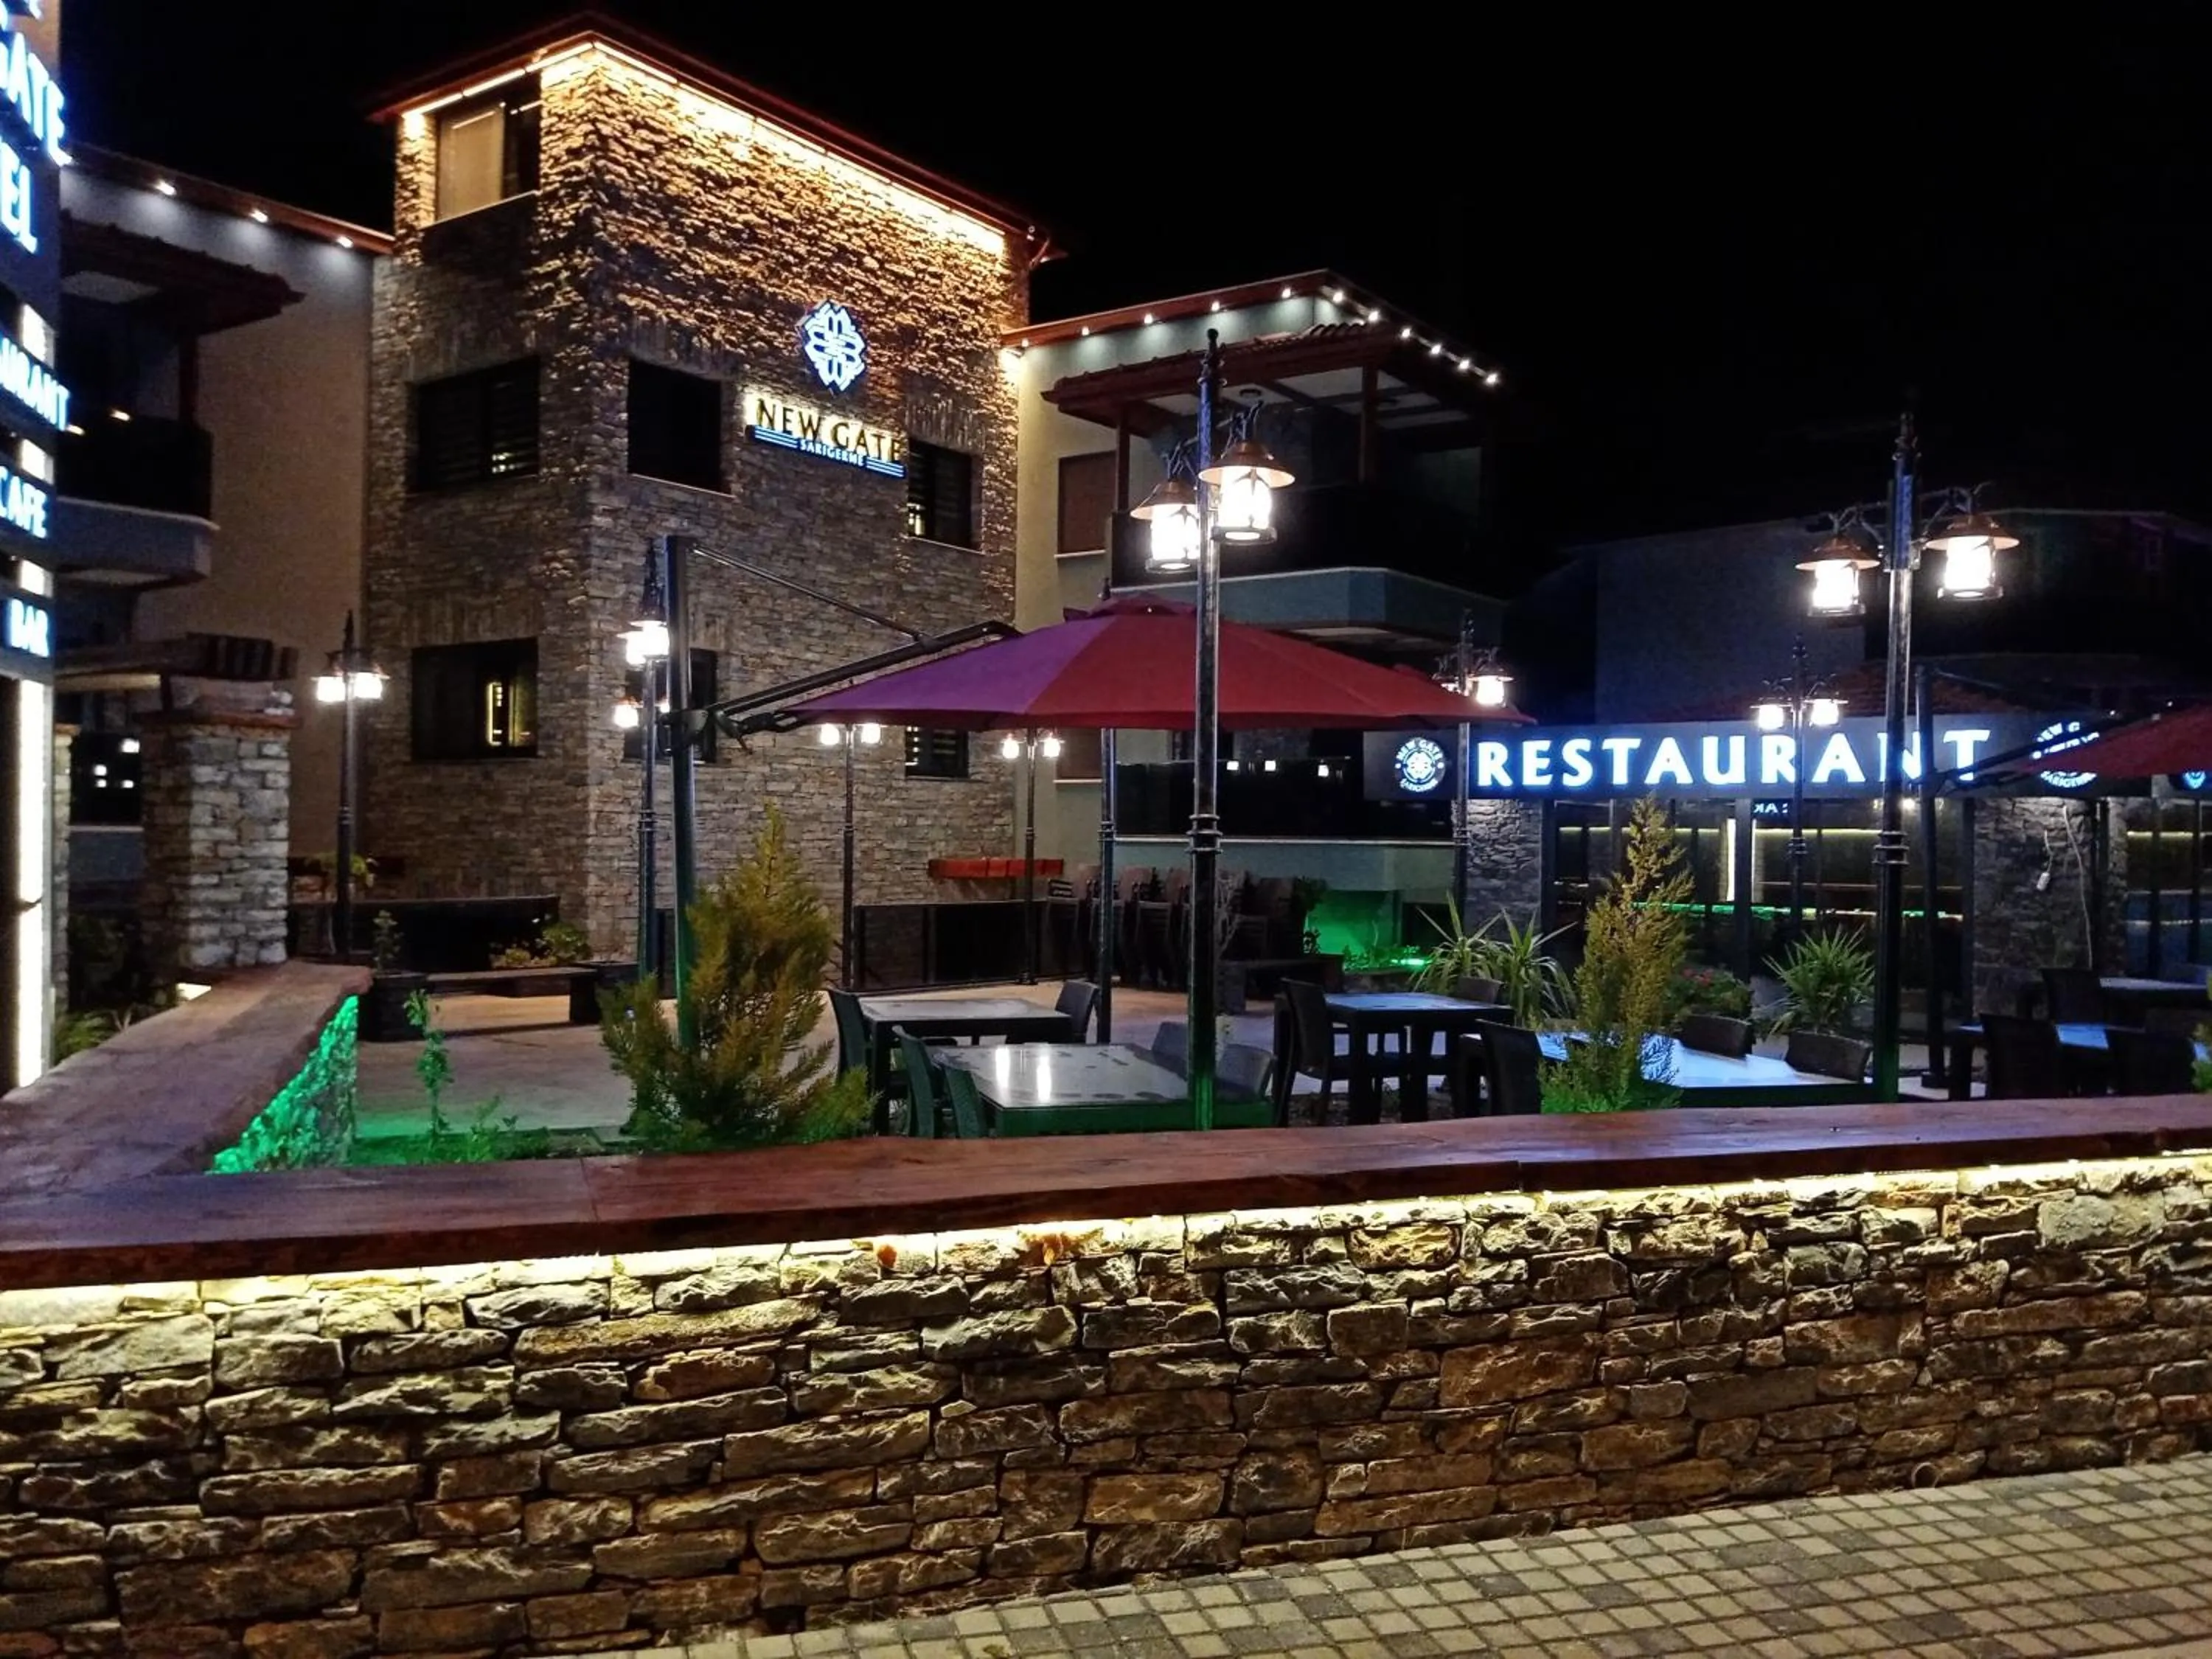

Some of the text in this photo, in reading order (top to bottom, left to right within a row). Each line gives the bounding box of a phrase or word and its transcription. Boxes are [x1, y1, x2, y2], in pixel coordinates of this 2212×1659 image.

[0, 136, 37, 254] EL
[757, 397, 905, 461] NEW GATE
[800, 439, 864, 467] SARIGERME
[11, 599, 49, 657] BAR
[1396, 740, 1443, 761] NEW GATE
[1477, 729, 1991, 787] RESTAURANT
